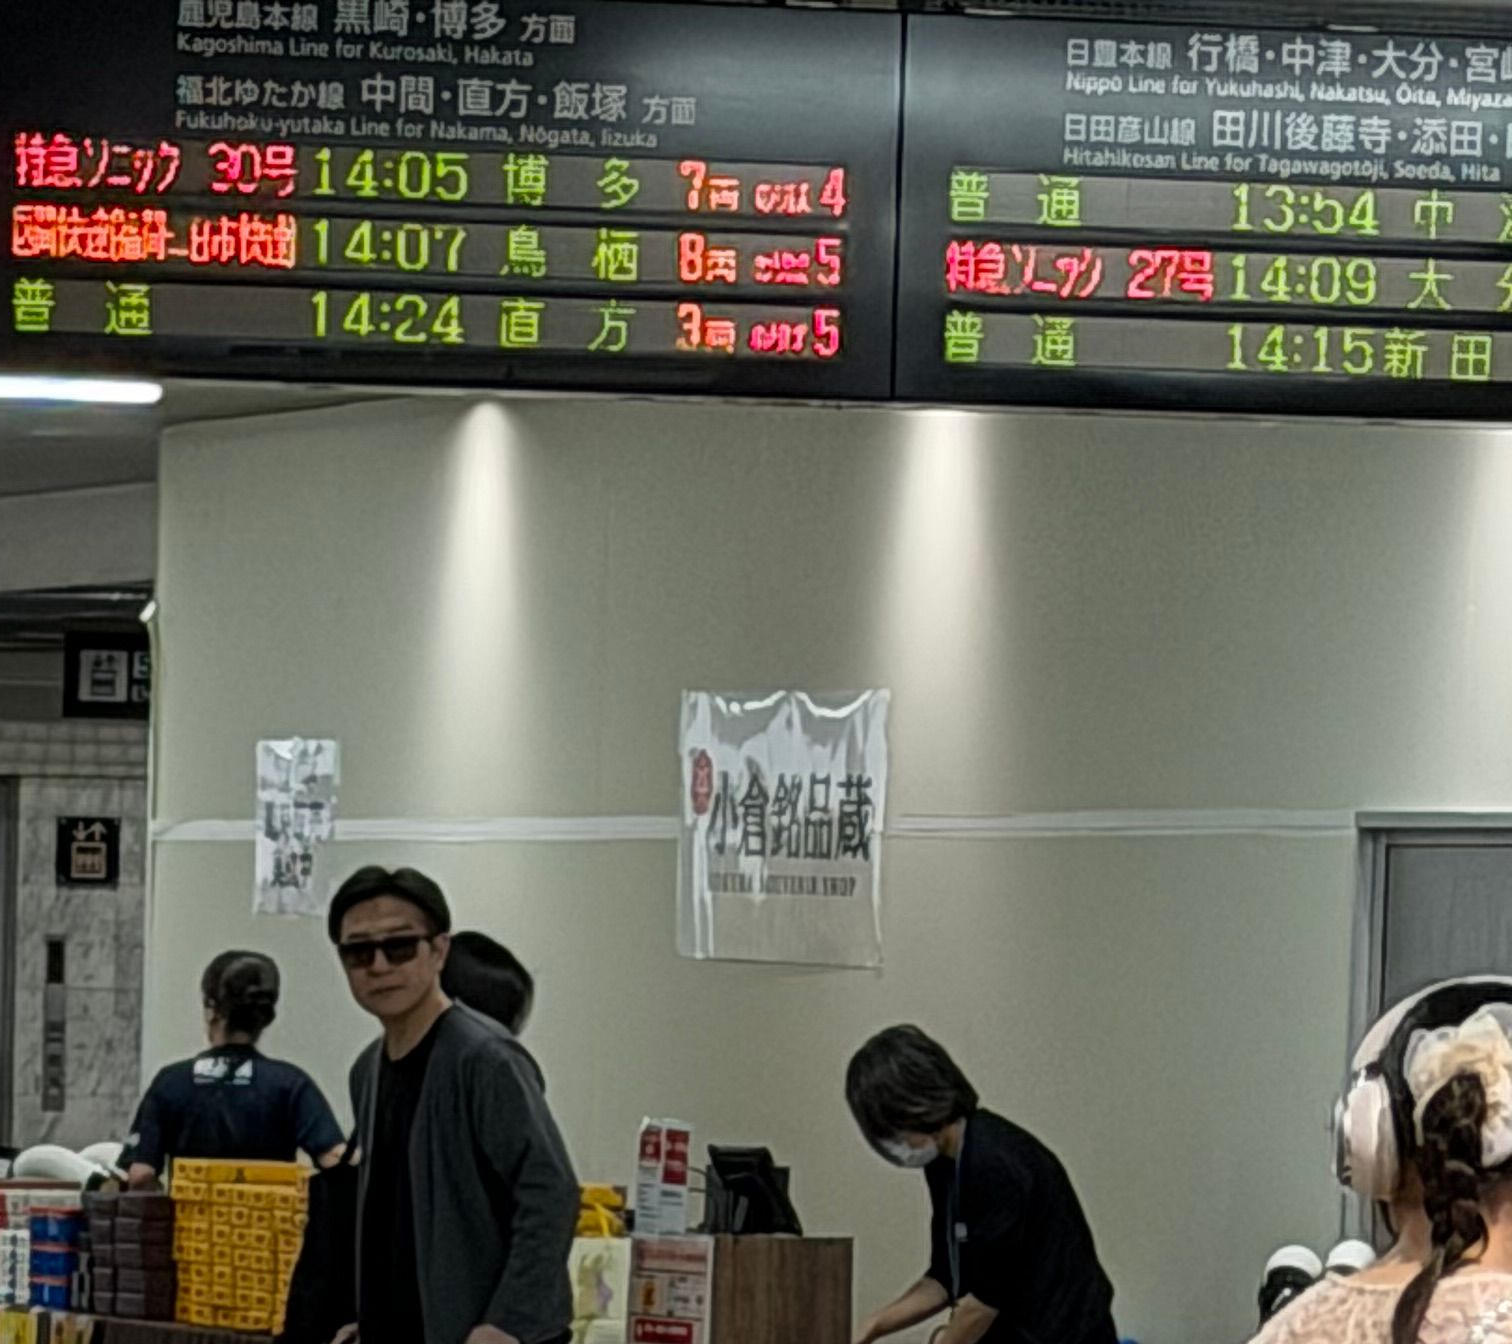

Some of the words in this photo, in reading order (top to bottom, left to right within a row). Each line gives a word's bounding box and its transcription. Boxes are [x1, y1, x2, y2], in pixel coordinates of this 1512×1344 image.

[334, 0, 508, 41] 黒崎・博多
[520, 13, 576, 44] 方面
[177, 32, 284, 59] Kagoshima
[290, 36, 329, 58] Line
[335, 37, 364, 60] for
[370, 41, 458, 65] Kurosaki,
[465, 44, 534, 67] Hakata
[362, 73, 628, 121] 中間・直方・飯塚
[642, 96, 697, 125] 方面
[1129, 74, 1165, 93] Line
[1172, 74, 1198, 94] for
[176, 109, 345, 138] Fukuhoku-yutaka
[351, 117, 390, 137] Line
[396, 118, 423, 138] for
[1064, 113, 1195, 145] 日田彦山線
[1213, 109, 1512, 159] 田川後藤寺・添田・
[312, 148, 468, 201] 14:05
[502, 153, 640, 208] 博多
[1181, 150, 1219, 170] Line
[1224, 152, 1252, 171] for
[1461, 163, 1500, 182] Hita
[949, 168, 1082, 228] 普通
[1232, 182, 1381, 237] 13:54
[312, 218, 466, 273] 14:07
[500, 224, 639, 282] 鳥栖
[1127, 247, 1214, 300] 27号
[1230, 253, 1377, 305] 14:09
[13, 277, 153, 335] 普通
[309, 289, 465, 345] 14:24
[500, 299, 637, 352] 直方
[945, 309, 1078, 367] 普通
[1226, 324, 1376, 375] 14:15
